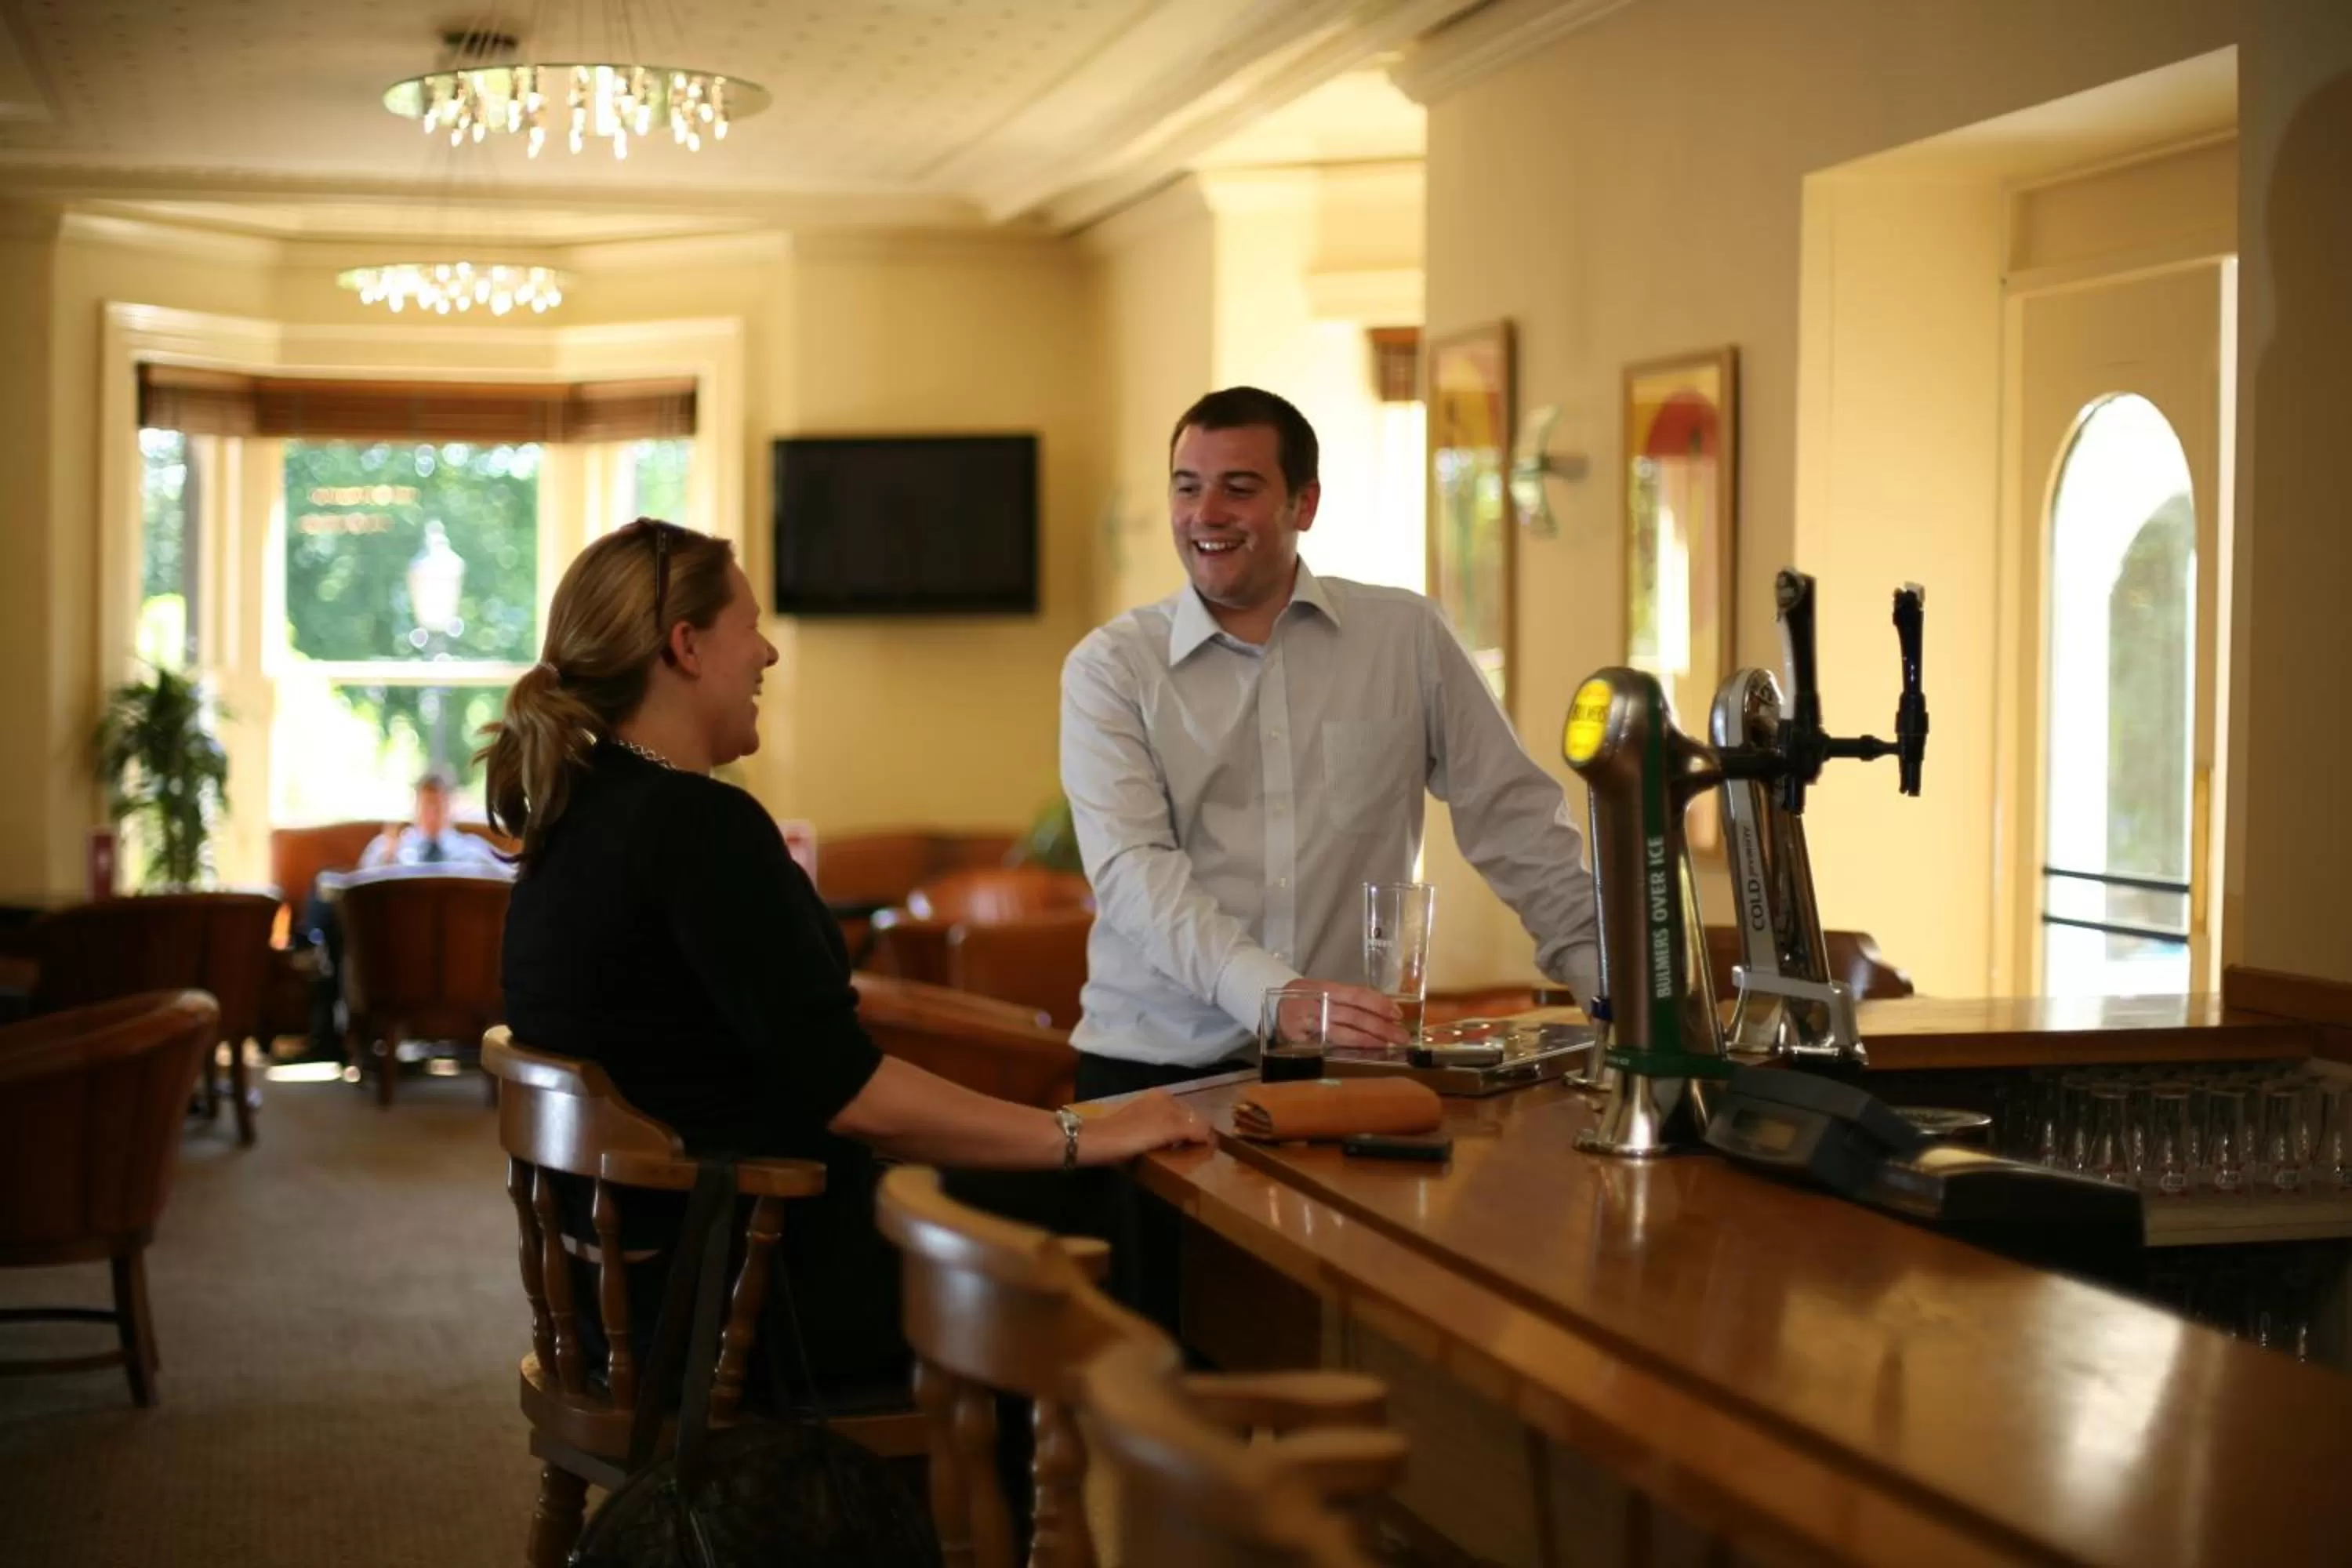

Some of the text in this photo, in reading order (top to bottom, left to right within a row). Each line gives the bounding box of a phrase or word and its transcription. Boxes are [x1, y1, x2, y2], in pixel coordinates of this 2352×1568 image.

[1647, 836, 1671, 998] BULMERS OVER ICE
[1748, 879, 1765, 931] COLD
